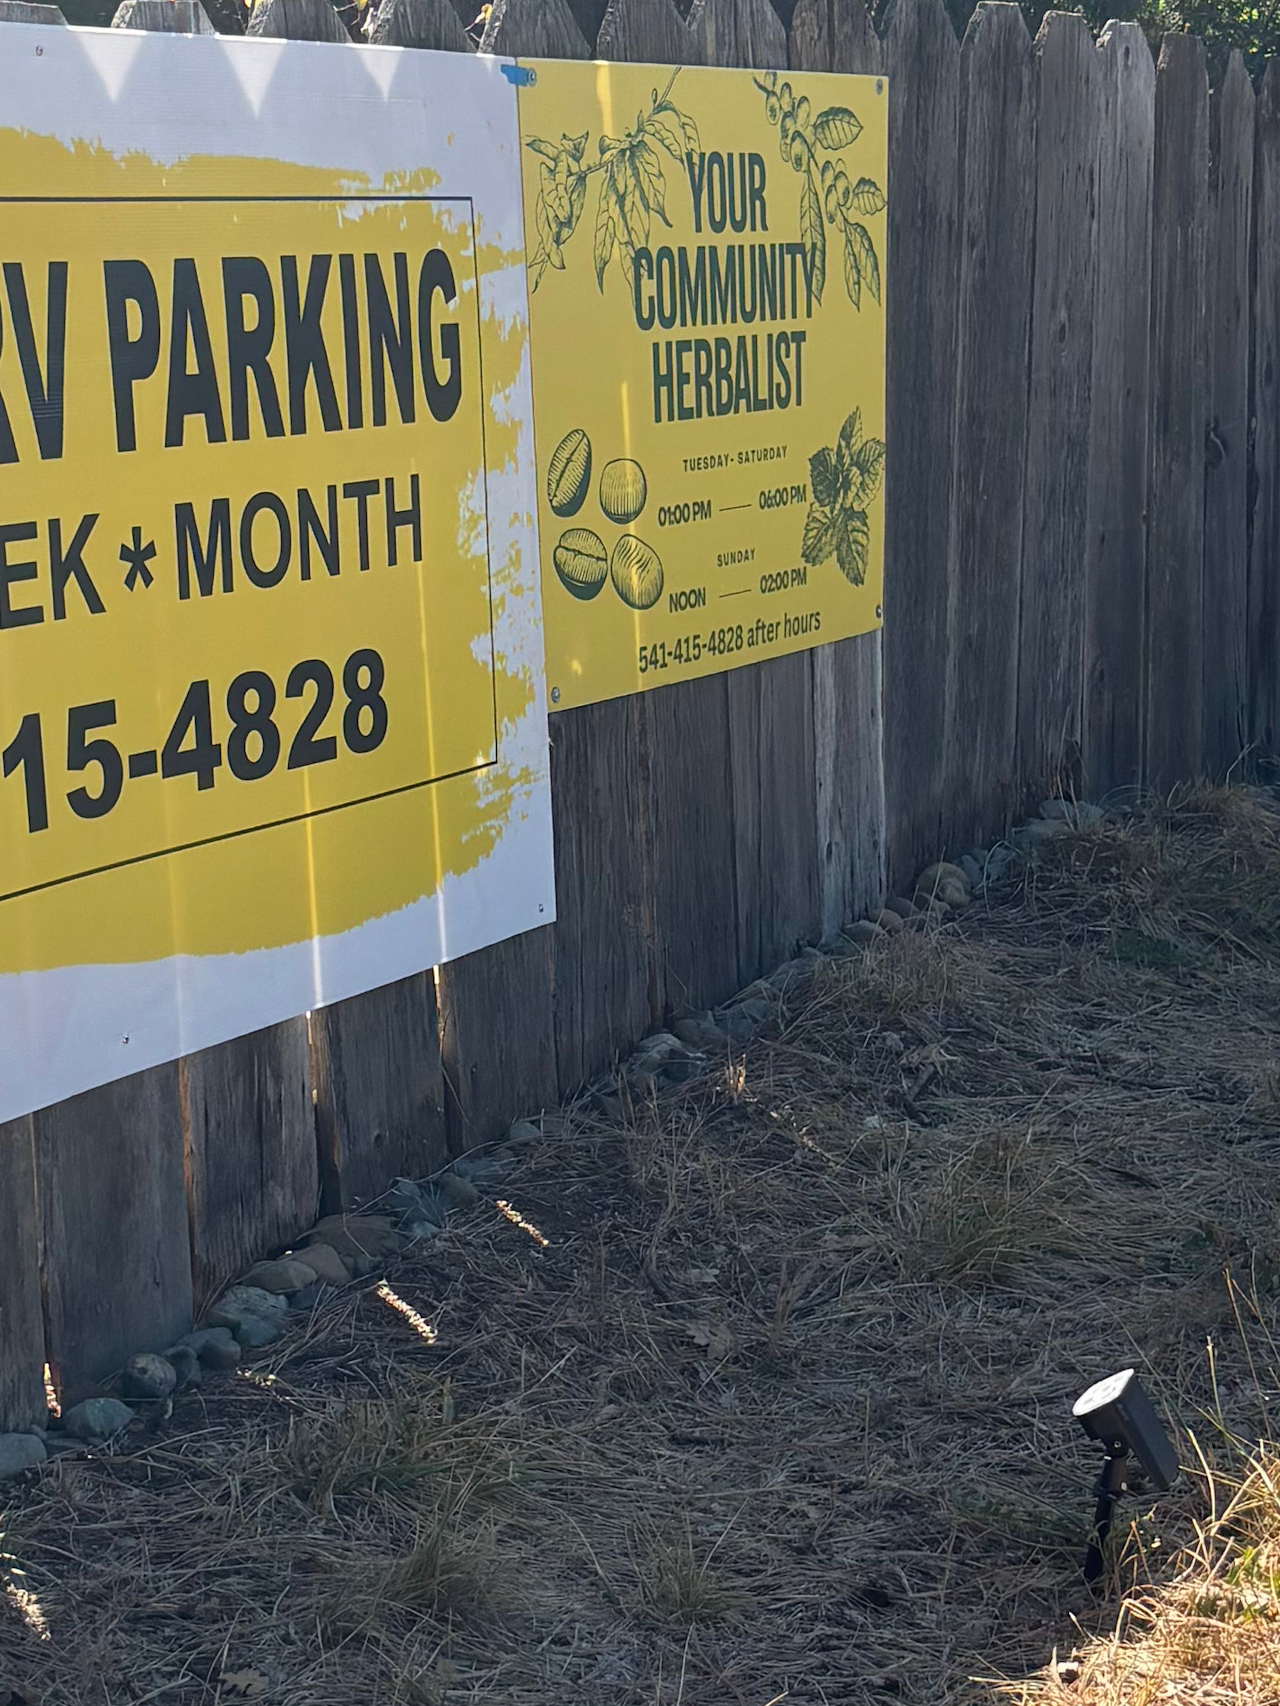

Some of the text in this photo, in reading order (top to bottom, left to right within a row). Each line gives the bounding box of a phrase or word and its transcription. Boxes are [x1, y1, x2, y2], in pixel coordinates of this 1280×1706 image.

[685, 151, 769, 234] YOUR
[632, 242, 818, 332] COMMUNITY
[103, 248, 462, 453] PARKING
[652, 330, 807, 424] HERBALIST
[737, 445, 788, 465] SATURDAY
[658, 502, 690, 527] 01:00
[692, 499, 712, 522] PM
[790, 484, 807, 505] PM
[716, 548, 755, 567] SUNDAY
[669, 587, 706, 613] NOON
[790, 566, 807, 588] PM
[638, 611, 821, 674] 541-415-4828 after hours
